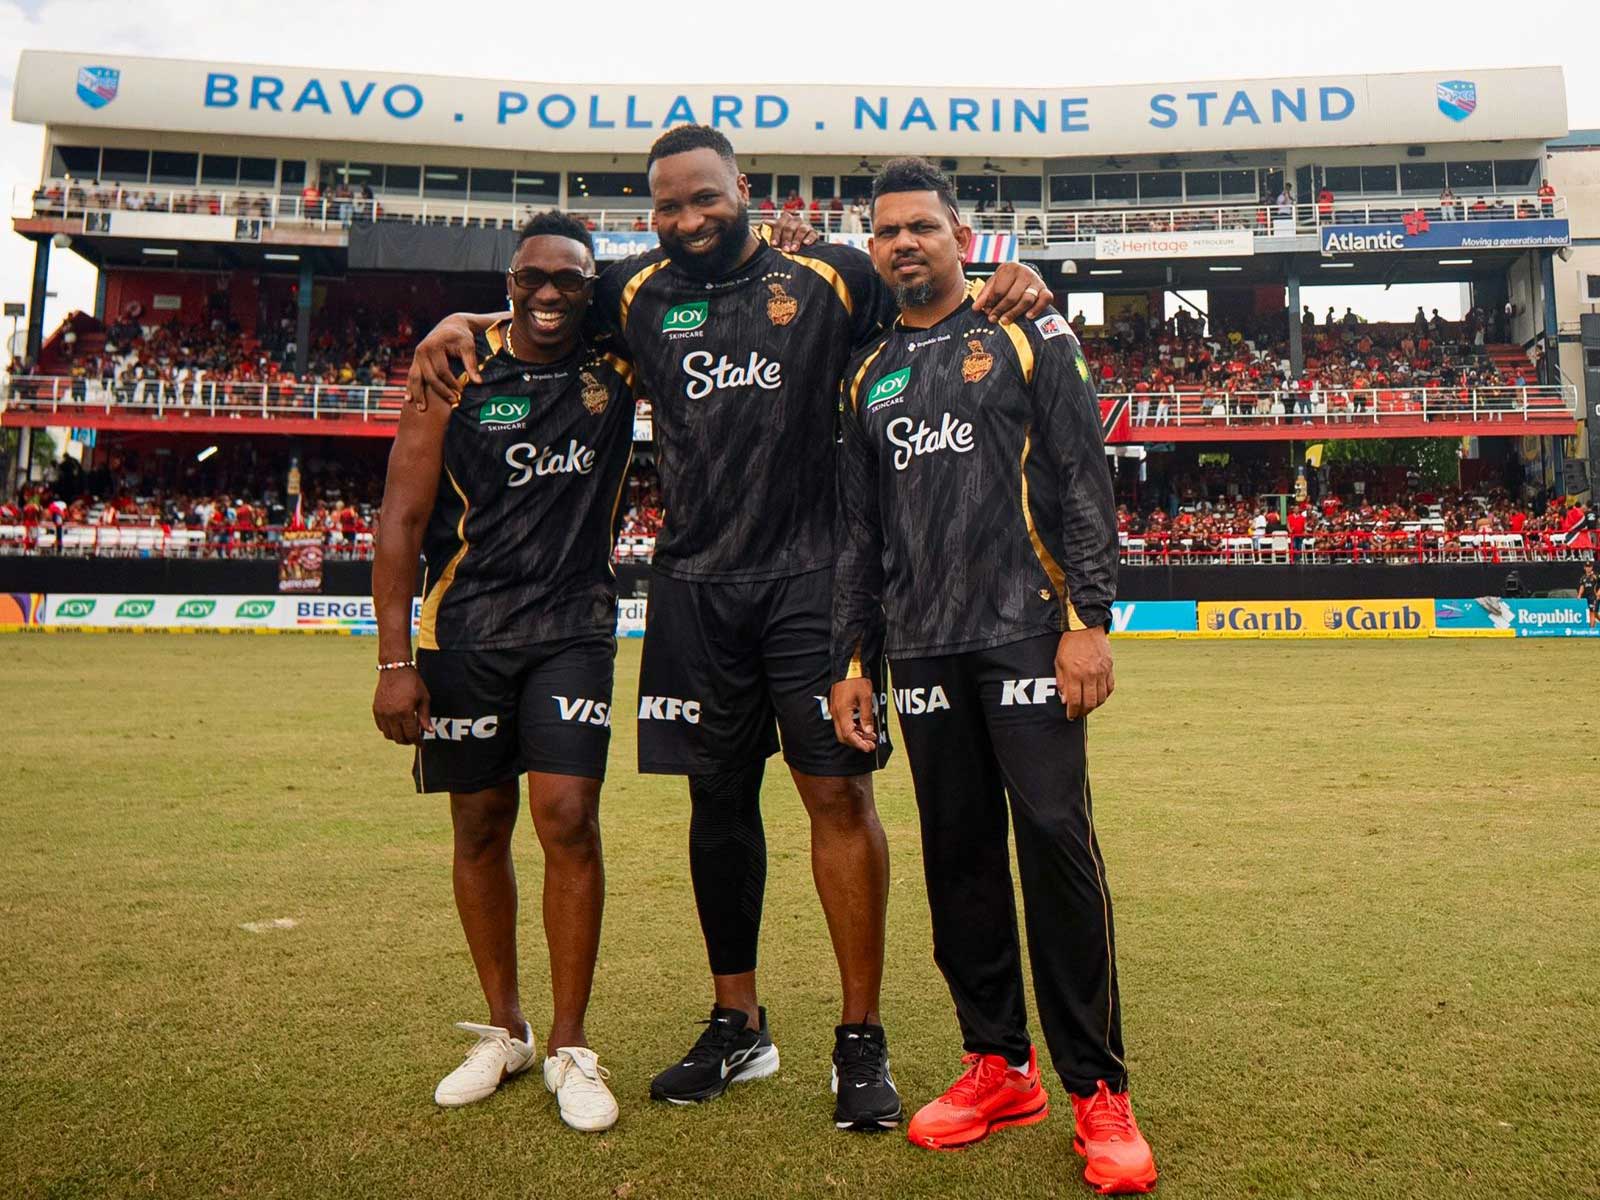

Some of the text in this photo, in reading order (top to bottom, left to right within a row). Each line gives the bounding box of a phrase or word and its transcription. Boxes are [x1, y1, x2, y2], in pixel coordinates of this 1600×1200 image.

[204, 73, 424, 119] BRAVO
[497, 91, 789, 129] POLLARD
[854, 96, 1089, 133] NARINE
[1149, 87, 1355, 129] STAND
[1122, 240, 1188, 252] Heritage
[1326, 231, 1404, 250] Atlantic
[1461, 237, 1492, 246] Moving
[1501, 236, 1542, 246] generation
[1543, 235, 1568, 244] ahead
[667, 309, 703, 324] JOY
[669, 330, 703, 340] SKINCARE
[683, 351, 781, 399] Stake
[872, 374, 905, 398] JOY
[485, 403, 525, 416] JOY
[871, 396, 904, 413] SKINCARE
[488, 422, 526, 431] SKINCARE
[887, 412, 975, 470] Stake
[505, 439, 595, 487] Stake
[60, 602, 91, 614] JOY
[119, 602, 150, 614] JOY
[180, 603, 212, 615] JOY
[240, 604, 271, 615] JOY
[297, 602, 372, 617] BERGE
[1518, 608, 1582, 627] Republic
[1228, 607, 1303, 630] Carib
[1346, 606, 1421, 630] Carib
[892, 685, 951, 715] VISA
[1000, 677, 1057, 705] KF
[638, 696, 700, 724] KFC
[423, 715, 498, 741] KFC
